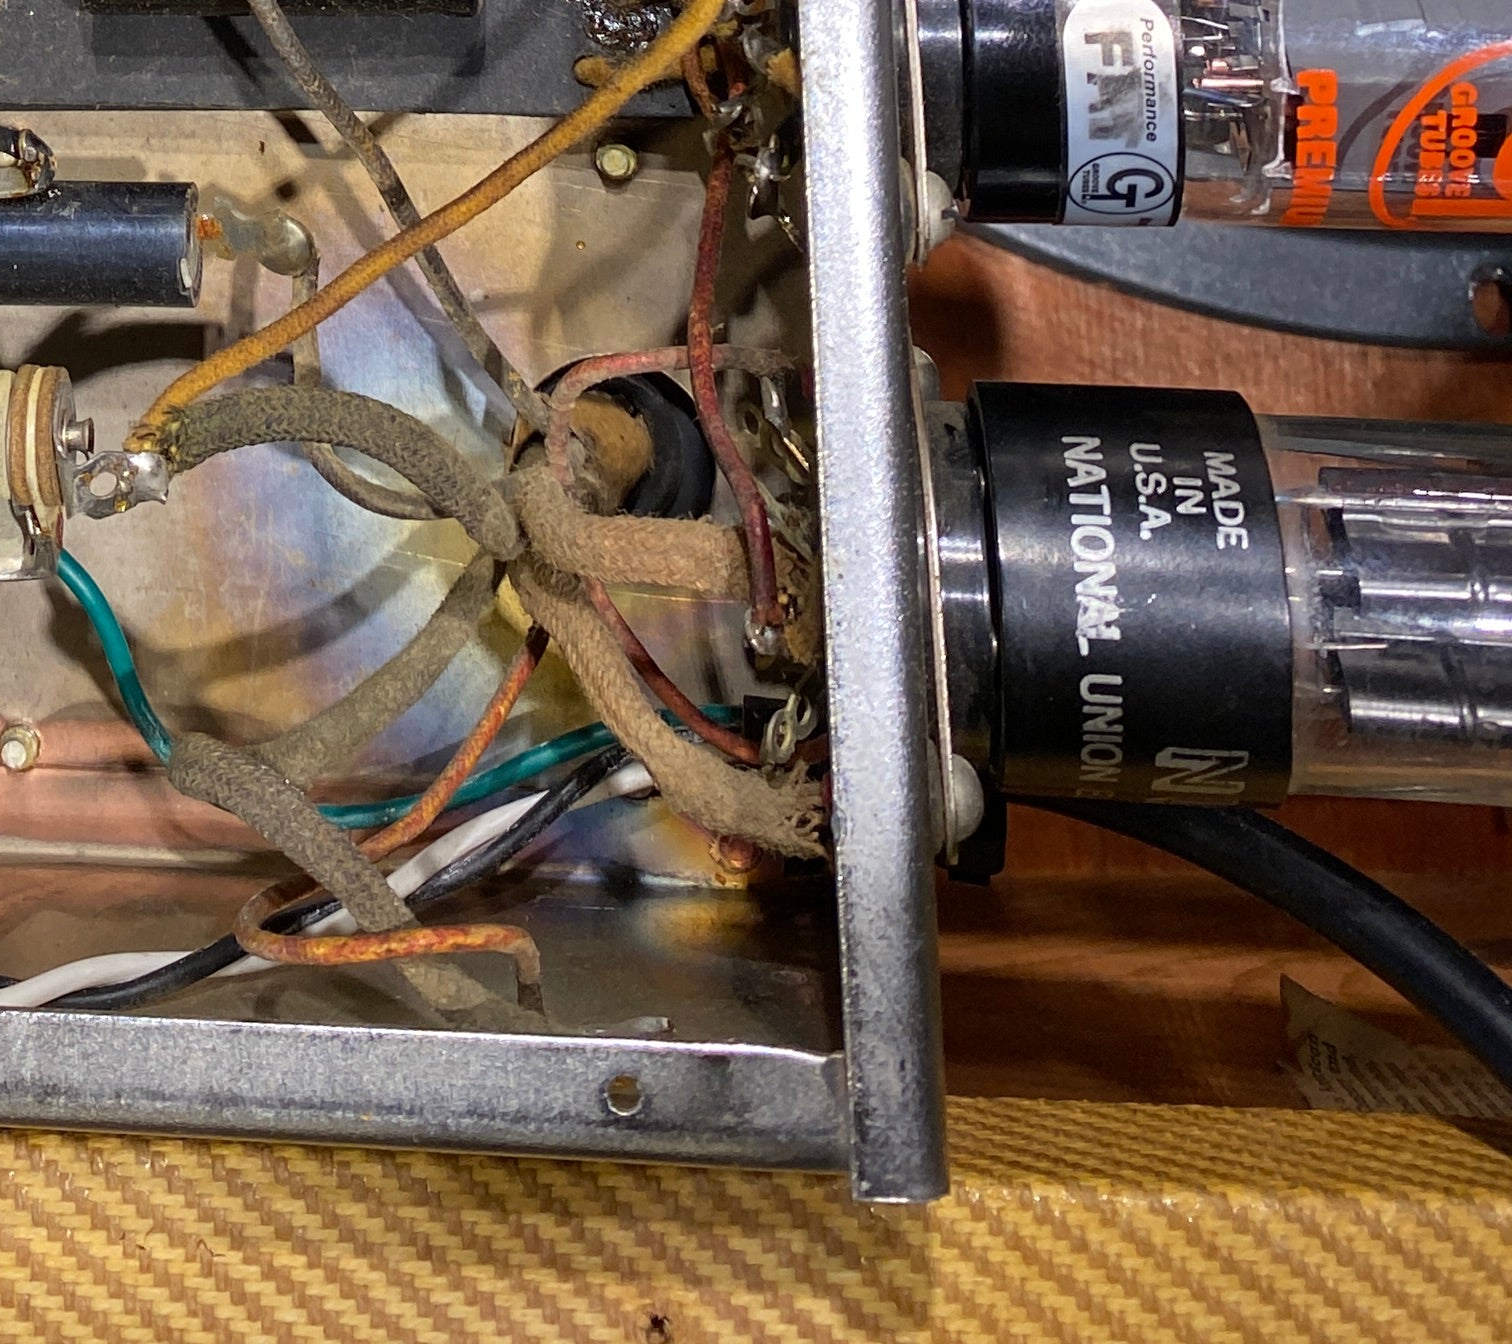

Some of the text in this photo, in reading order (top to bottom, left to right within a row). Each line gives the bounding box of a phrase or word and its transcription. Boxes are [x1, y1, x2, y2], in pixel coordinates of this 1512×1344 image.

[1140, 18, 1159, 143] Performance
[1414, 110, 1448, 198] TUBES
[1445, 81, 1479, 199] GROOVE
[1128, 442, 1173, 540] U.S.A.
[1173, 476, 1207, 515] IN
[1203, 450, 1249, 551] MADE
[1061, 435, 1123, 656] NATIONAL
[1078, 673, 1125, 783] UNION
